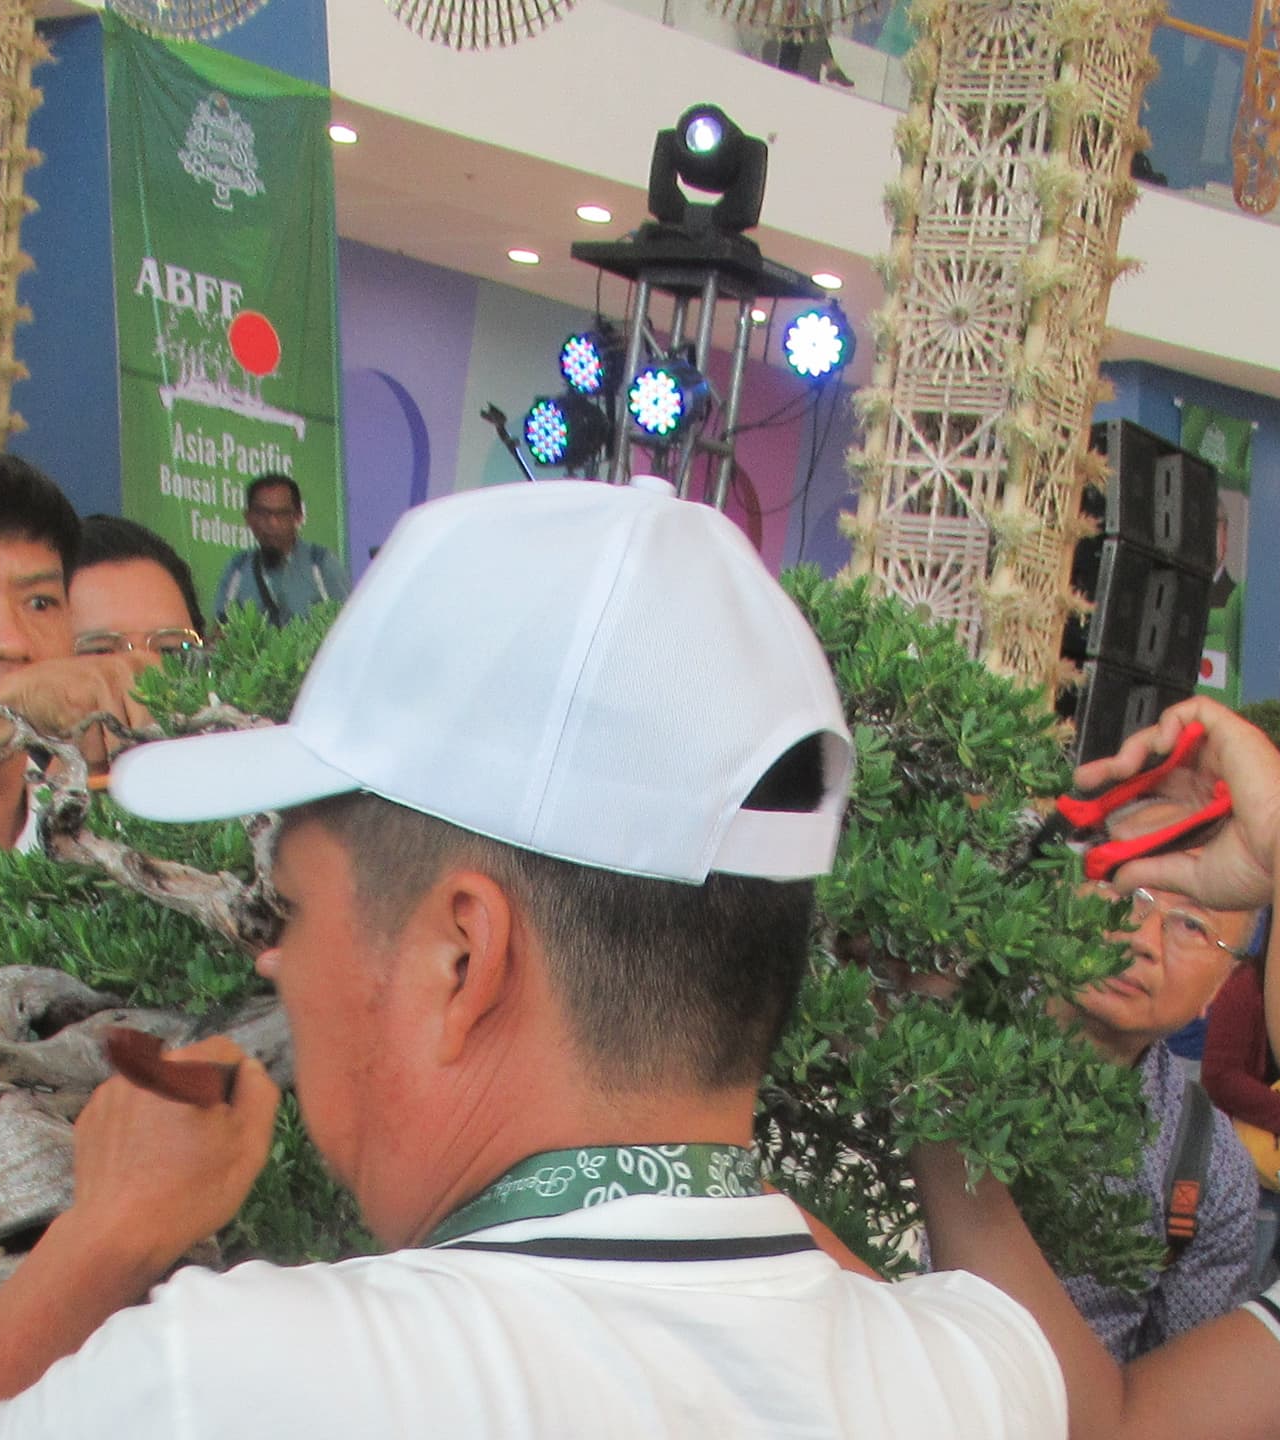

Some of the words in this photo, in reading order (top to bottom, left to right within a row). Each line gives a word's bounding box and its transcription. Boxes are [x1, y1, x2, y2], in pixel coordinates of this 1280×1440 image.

[135, 257, 243, 319] ABFF
[172, 420, 293, 477] Asia-Pacific
[160, 463, 217, 506] Bonsai
